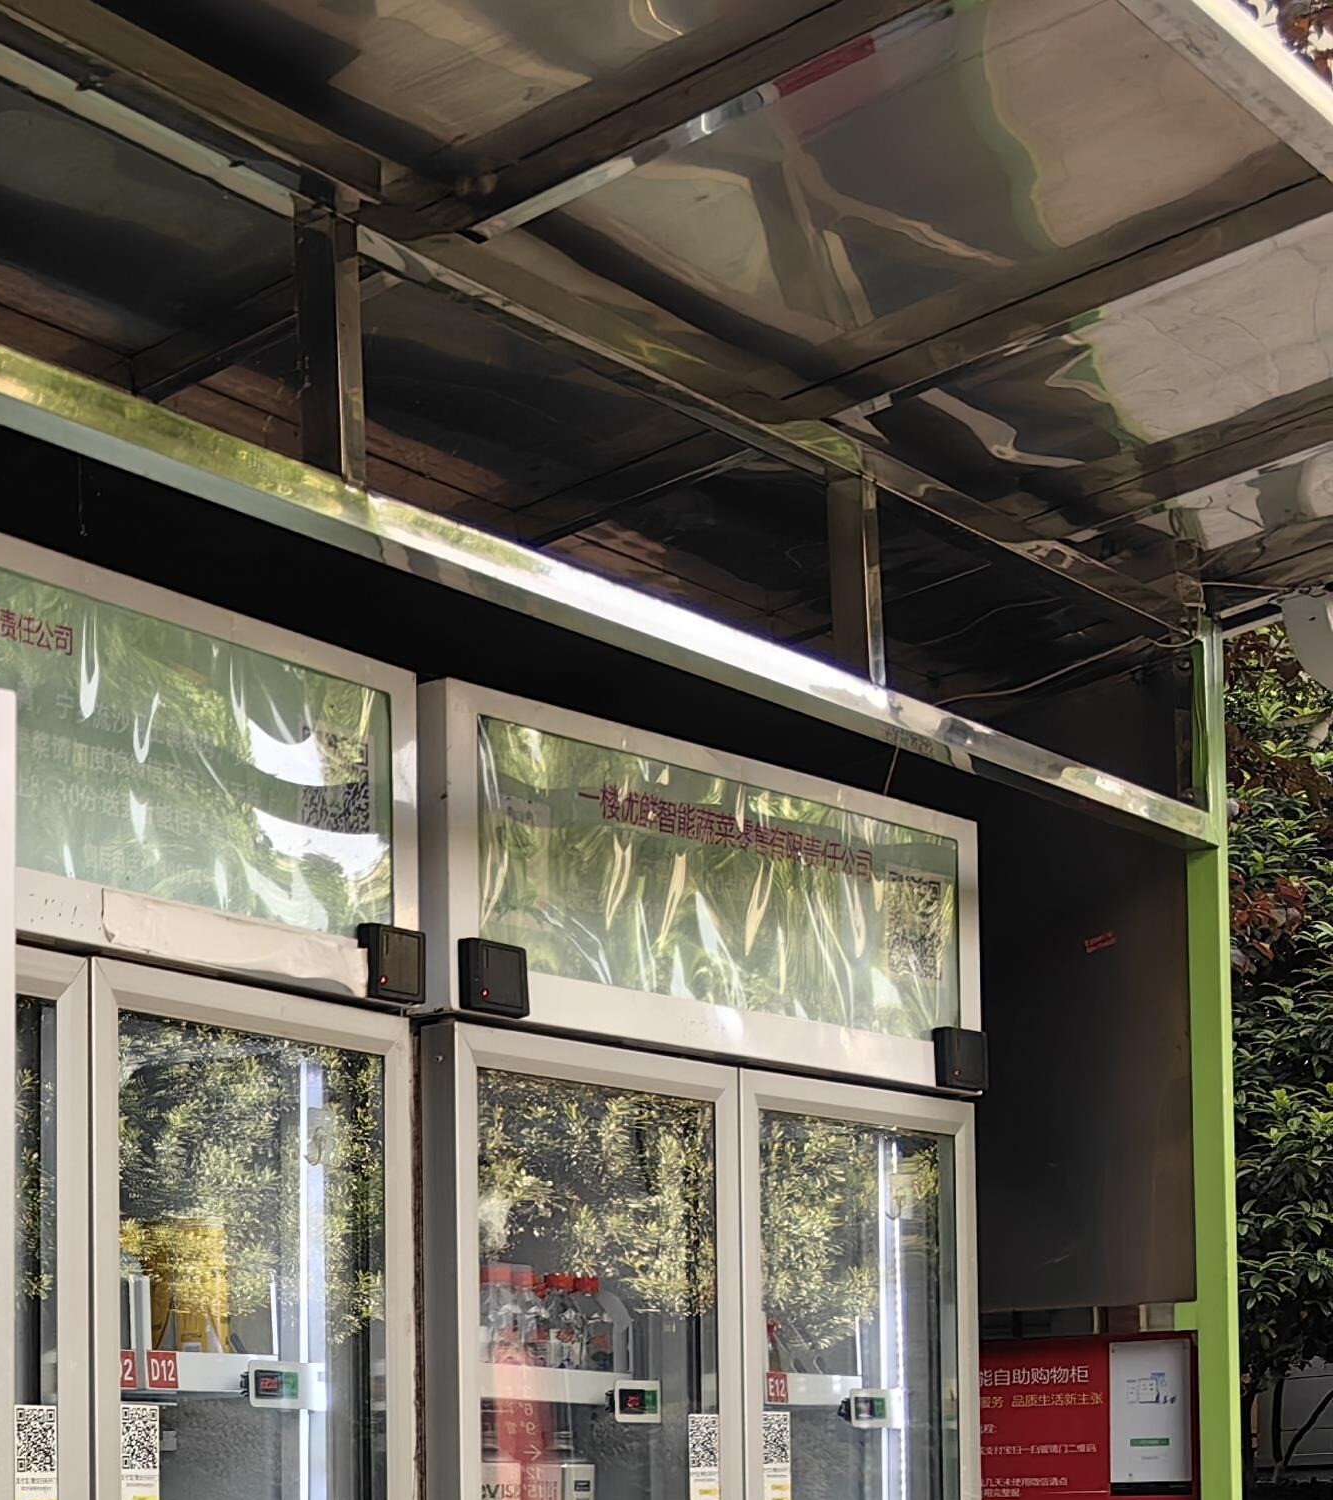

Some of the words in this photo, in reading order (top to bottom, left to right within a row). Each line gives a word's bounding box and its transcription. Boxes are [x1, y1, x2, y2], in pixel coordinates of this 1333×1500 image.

[150, 1358, 176, 1383] D12
[980, 1365, 1090, 1388] 能自助购物柜
[768, 1377, 786, 1398] E12
[1011, 1392, 1104, 1408] 品质生活新主张
